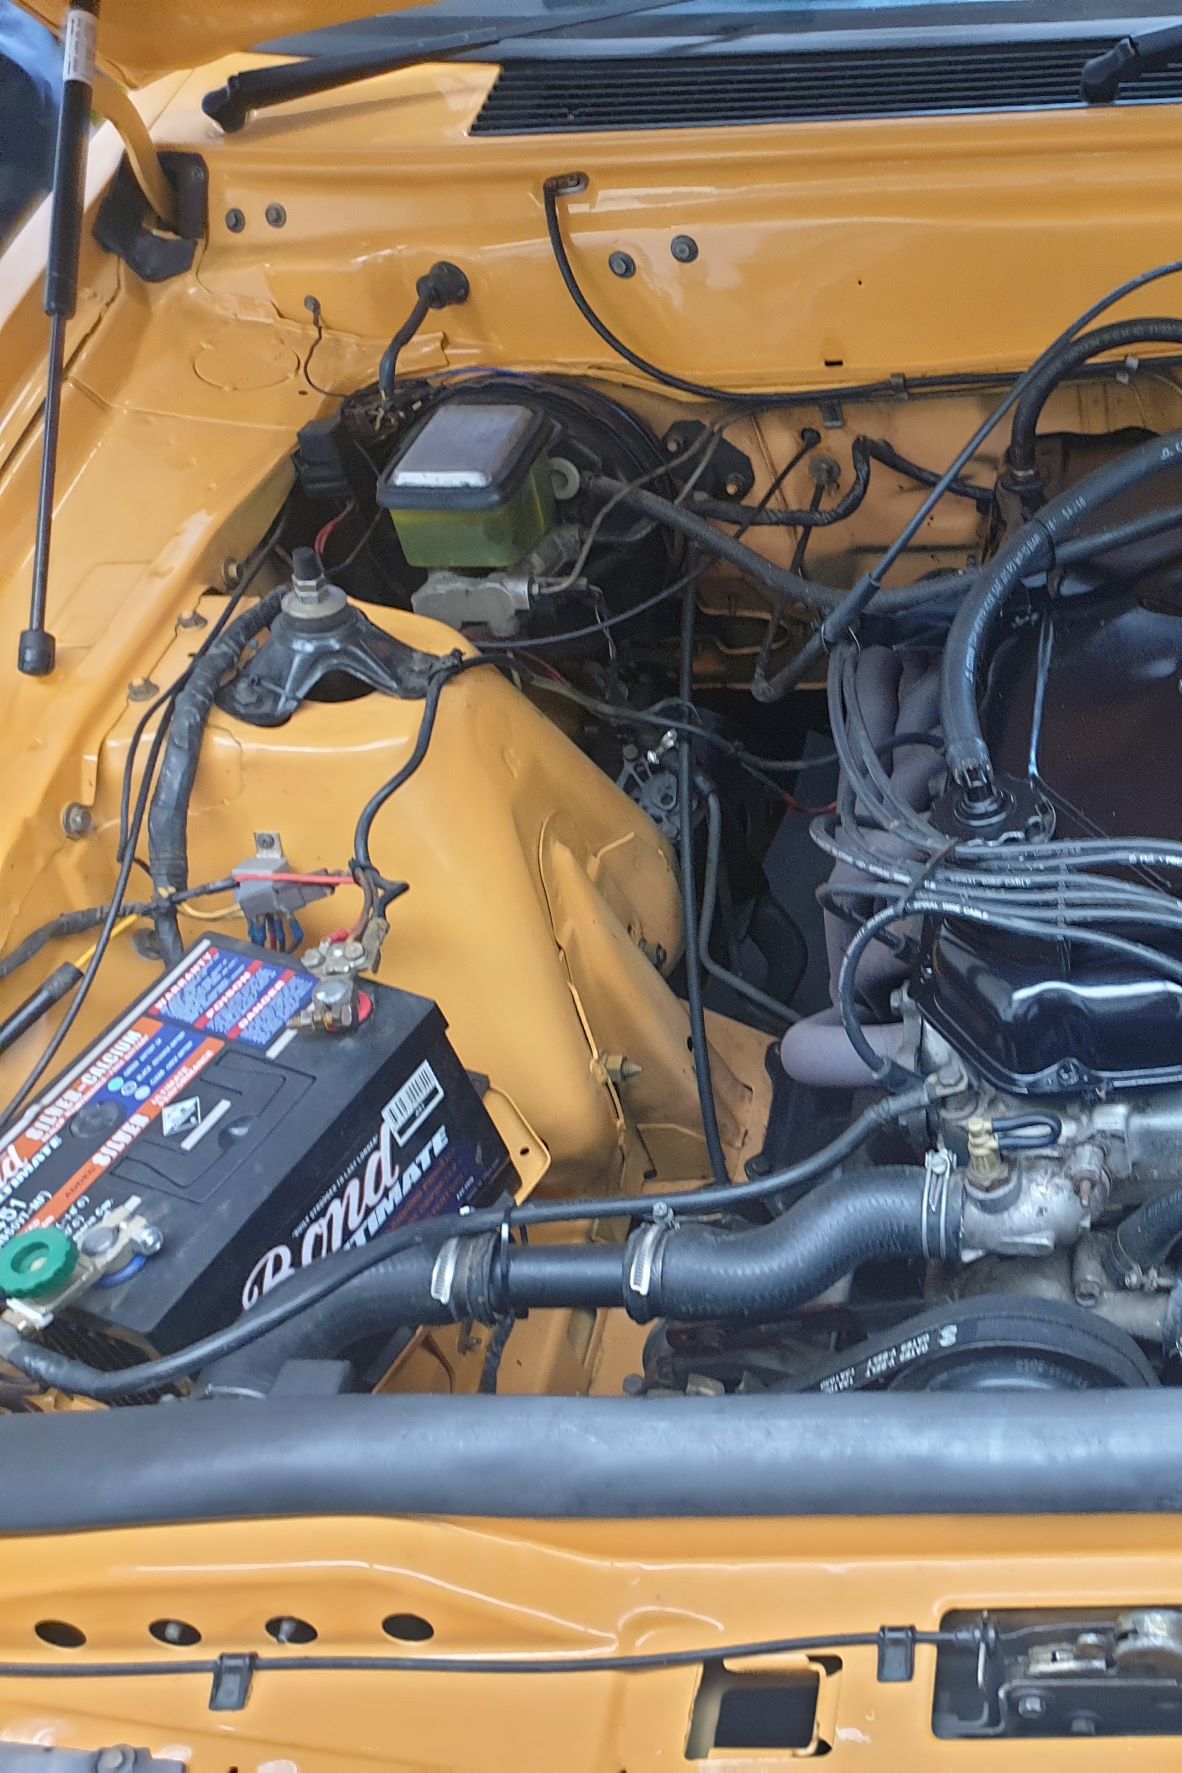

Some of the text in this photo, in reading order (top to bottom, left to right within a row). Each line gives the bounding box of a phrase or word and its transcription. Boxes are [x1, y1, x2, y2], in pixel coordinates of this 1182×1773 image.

[154, 951, 213, 1010] WARRANTY
[205, 970, 252, 1019] POISON
[238, 979, 286, 1030] DANGER
[25, 1029, 143, 1140] SILVER-CALCIUM
[91, 1113, 150, 1167] SILVER
